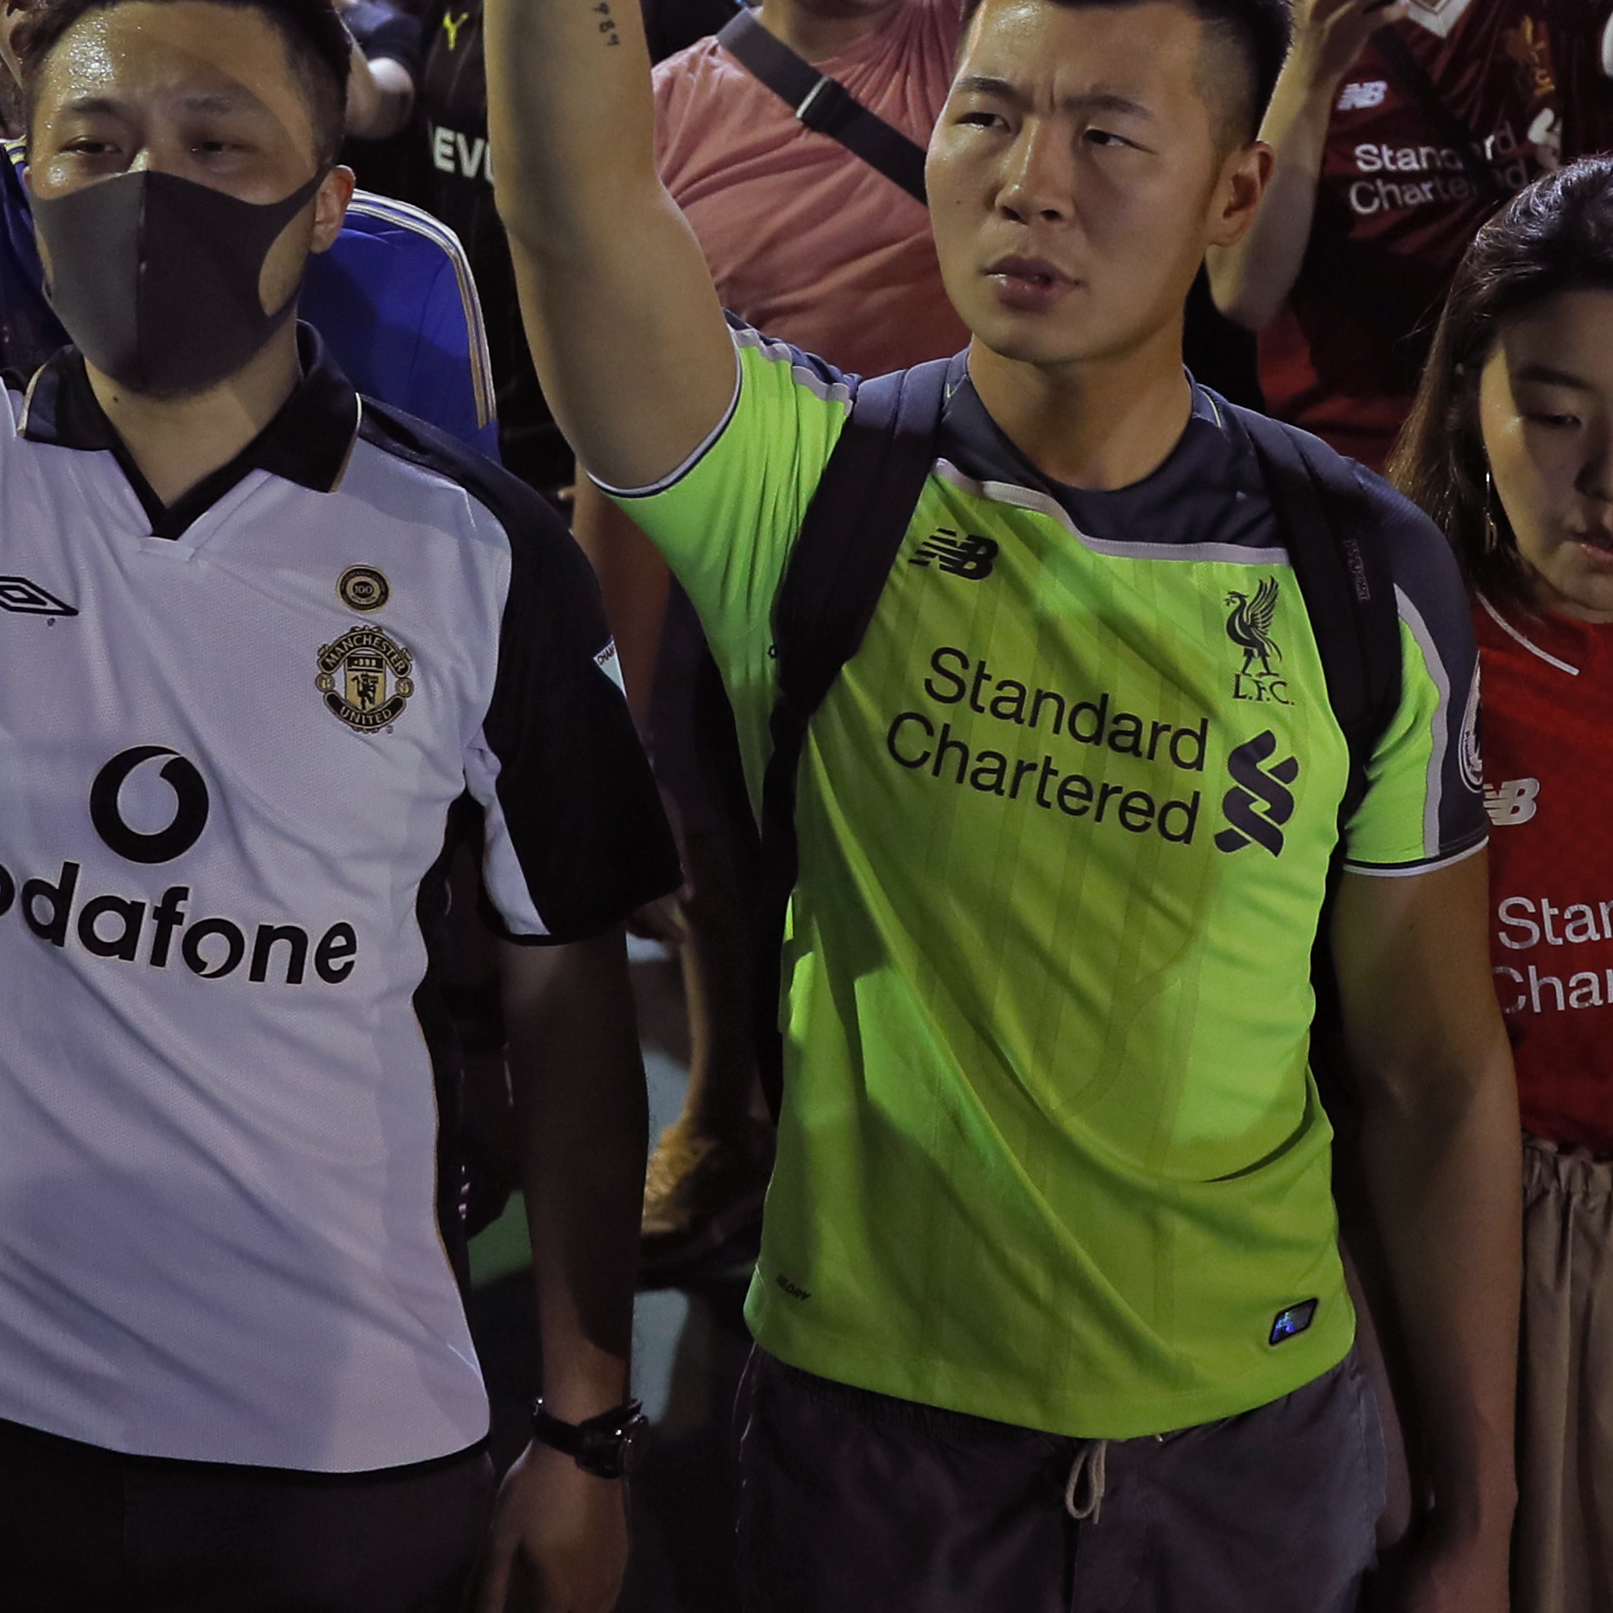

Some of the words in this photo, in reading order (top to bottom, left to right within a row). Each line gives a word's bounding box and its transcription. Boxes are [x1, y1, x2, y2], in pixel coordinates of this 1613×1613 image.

[433, 125, 494, 184] EV
[908, 527, 999, 581] NB
[325, 634, 406, 673] MANCHESTER
[339, 706, 393, 725] UNITED
[924, 646, 1209, 773] Standard
[1233, 673, 1295, 705] L.F.C.
[887, 711, 1201, 845] Chartered
